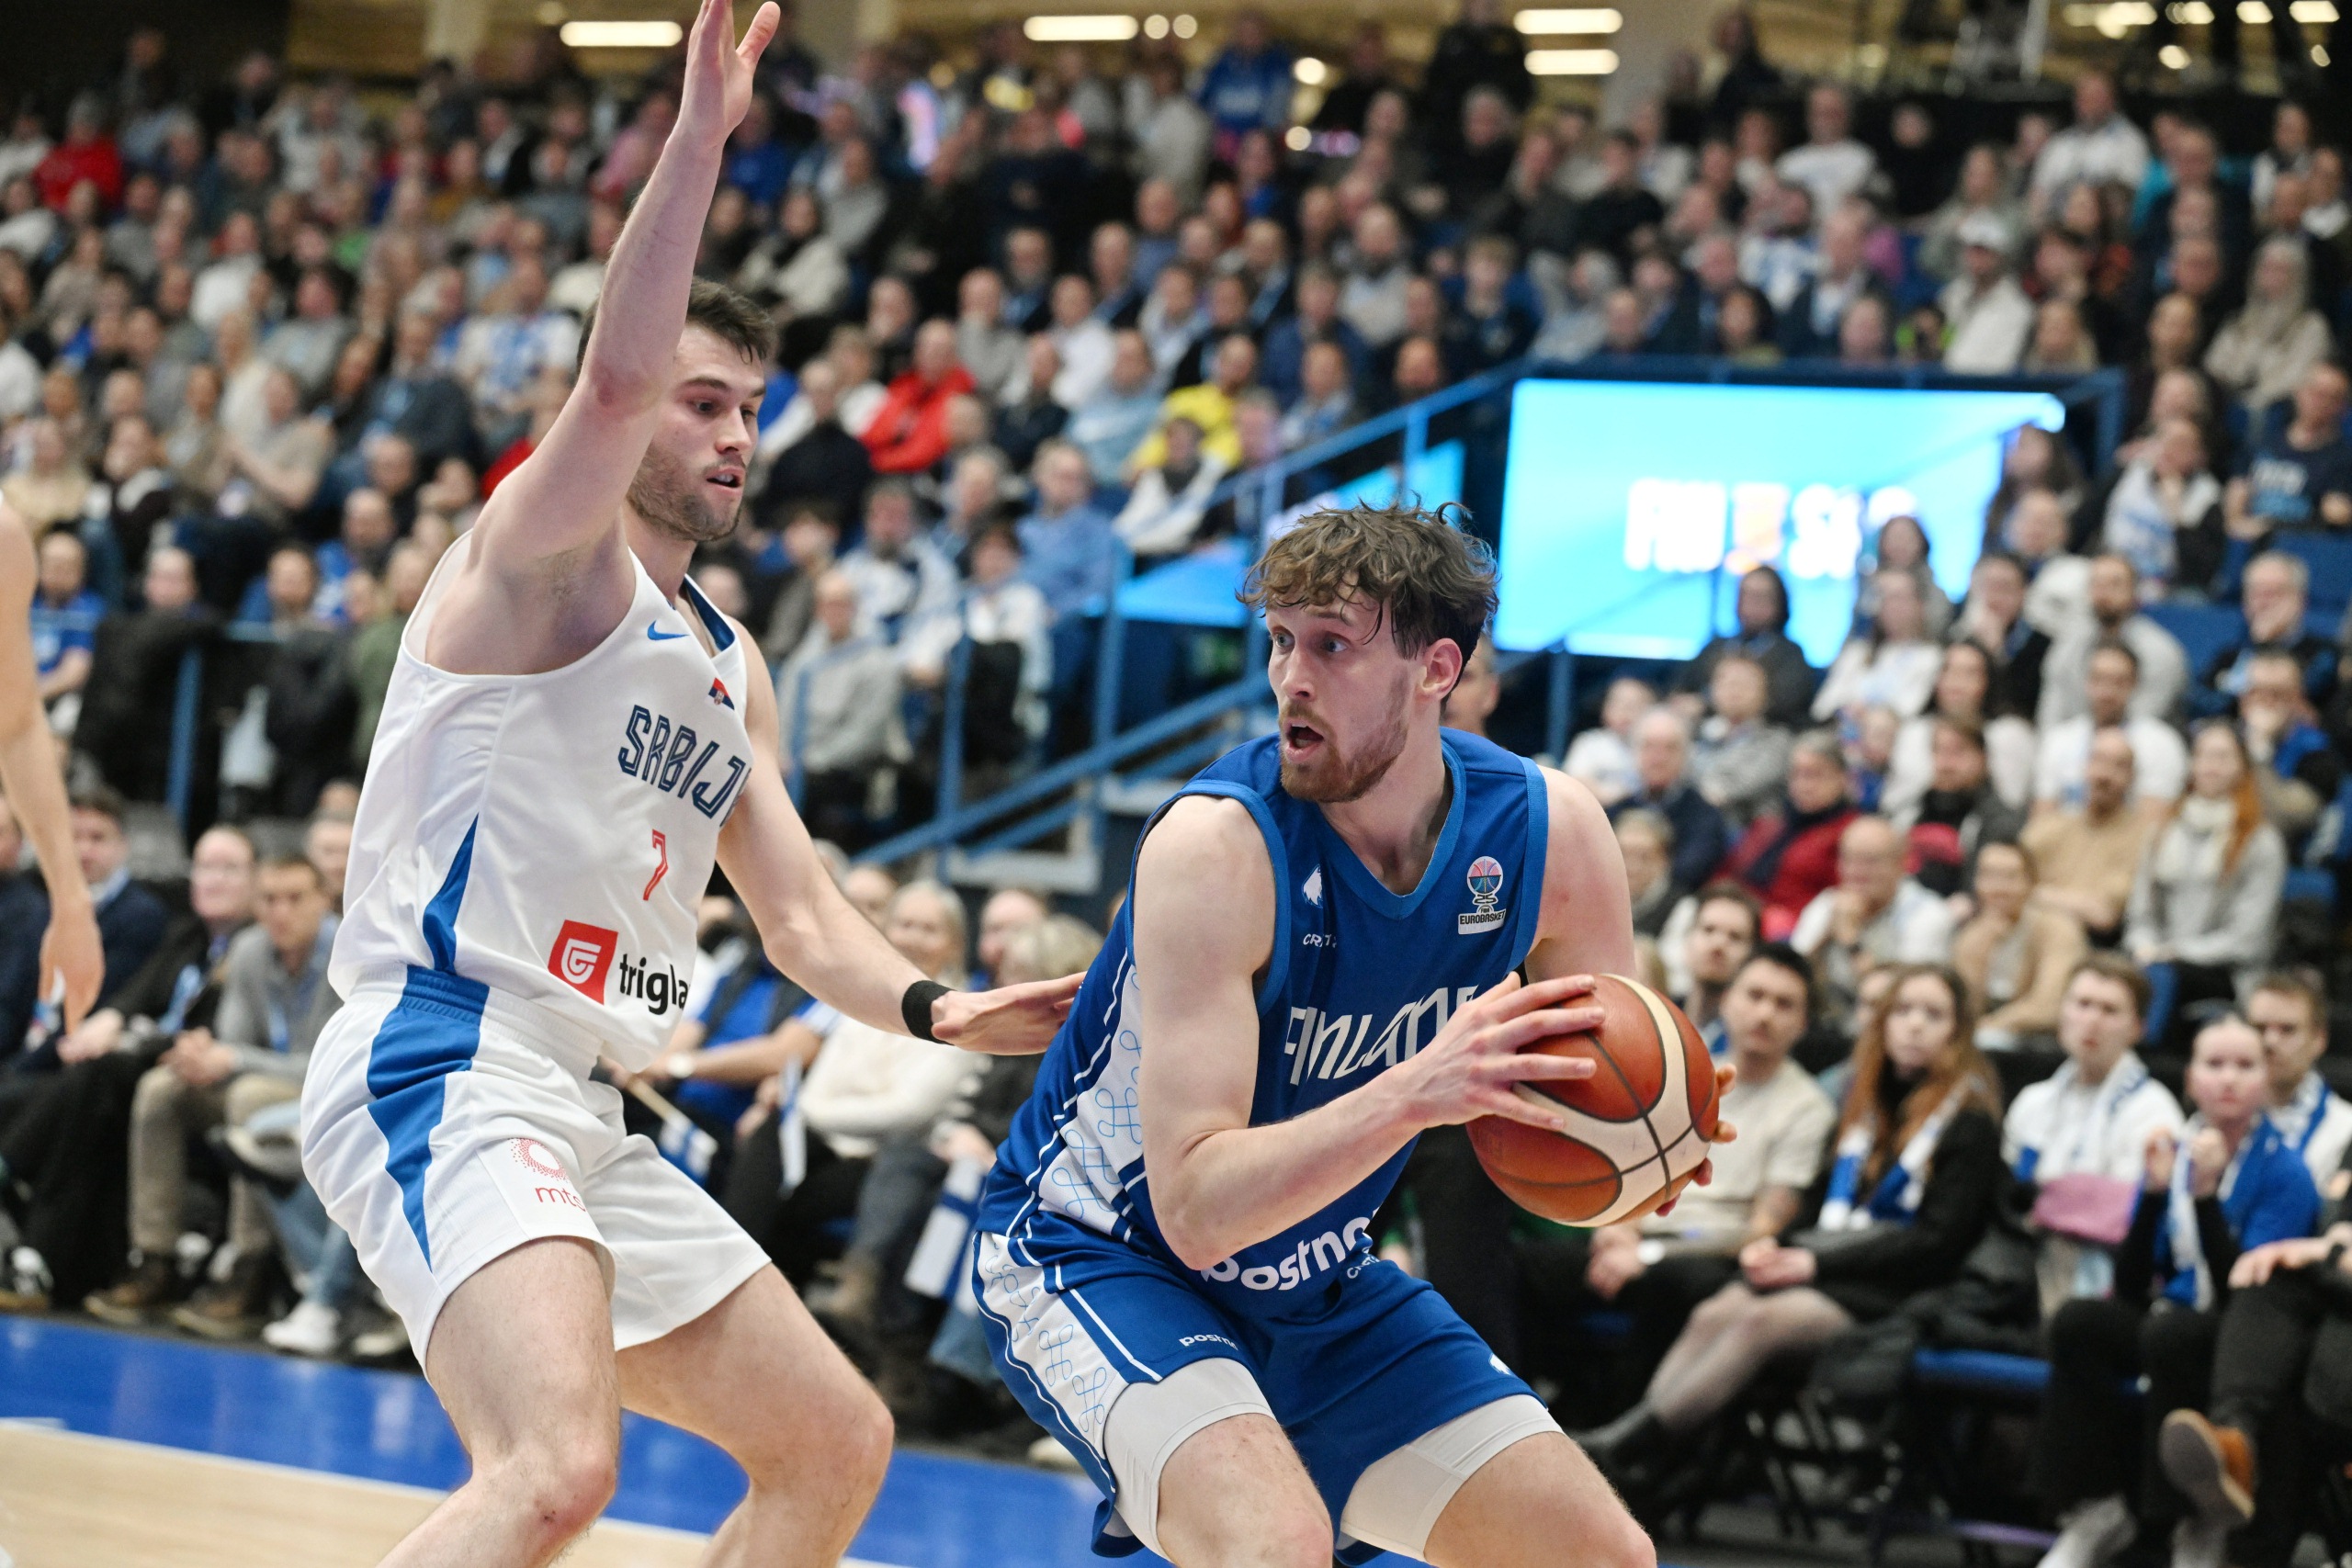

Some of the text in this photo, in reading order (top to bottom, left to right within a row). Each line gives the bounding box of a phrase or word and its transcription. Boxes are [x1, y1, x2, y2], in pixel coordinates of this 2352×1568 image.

[618, 705, 752, 827] SRBIJ
[643, 829, 668, 901] 7
[1460, 911, 1505, 924] EUROBASKET
[619, 953, 690, 1016] trigla
[535, 1187, 586, 1212] mts
